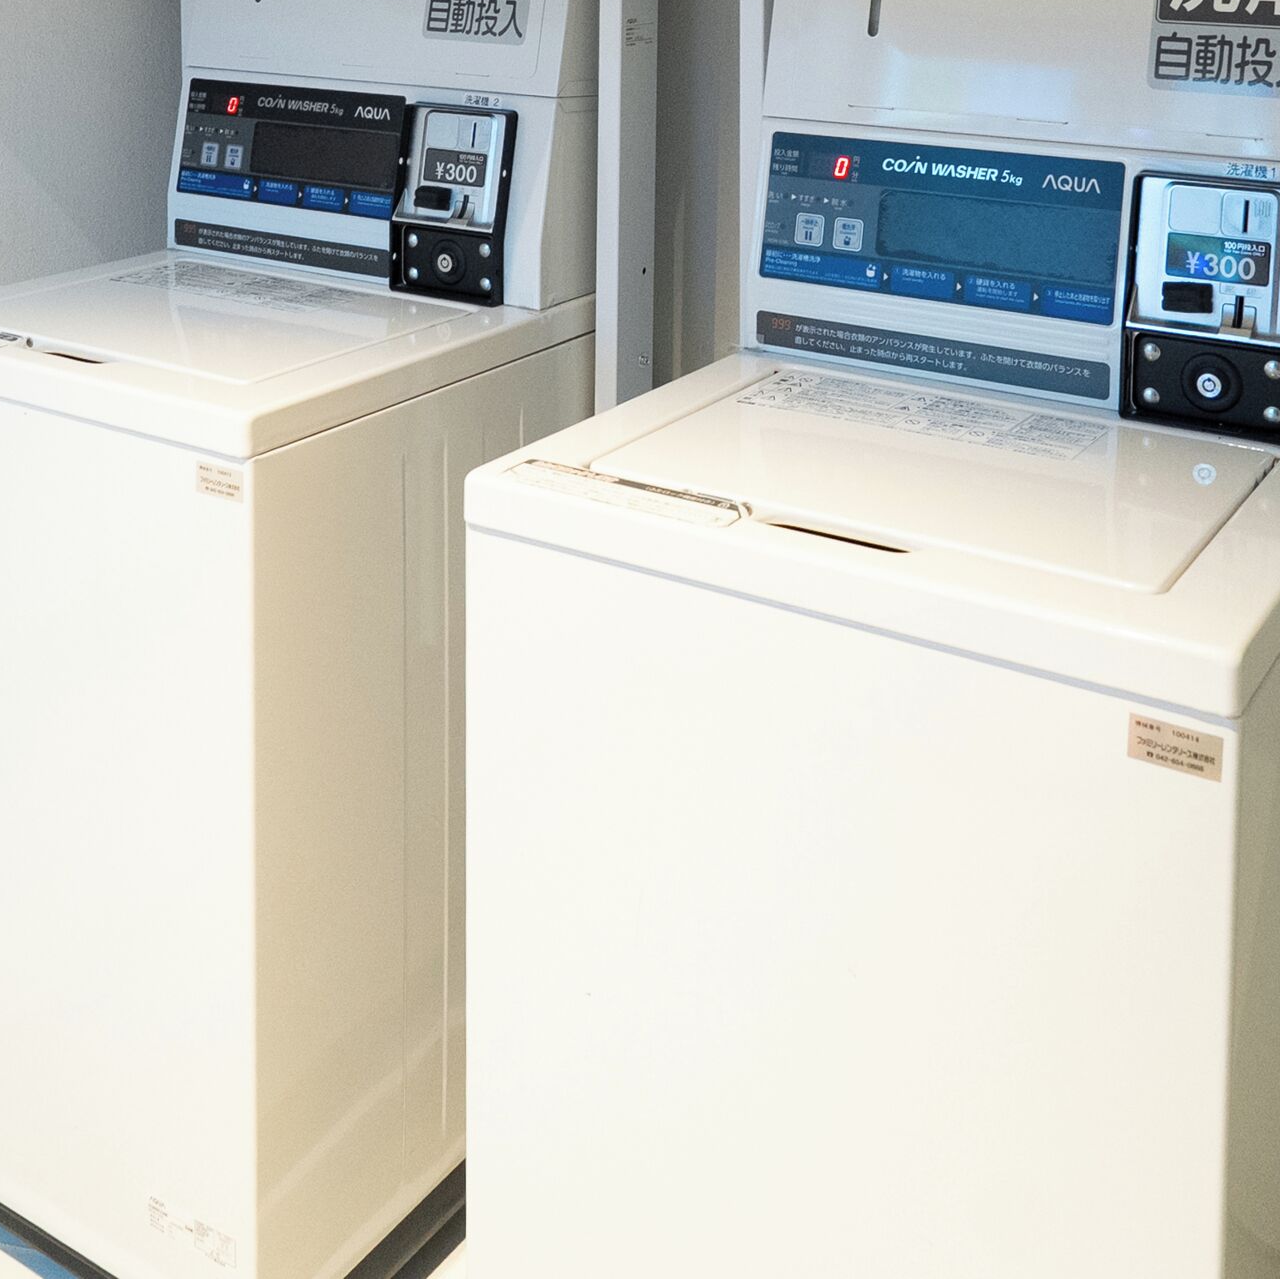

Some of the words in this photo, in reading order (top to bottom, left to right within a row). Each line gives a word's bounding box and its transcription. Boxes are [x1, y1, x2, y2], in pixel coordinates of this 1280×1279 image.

[227, 96, 239, 114] 0
[287, 100, 328, 114] WASHER
[493, 98, 500, 107] 2
[354, 106, 391, 120] AQUA
[435, 161, 477, 183] ¥300
[833, 156, 850, 178] 0
[931, 162, 998, 182] WASHER
[1000, 170, 1023, 186] 5kg
[1226, 162, 1268, 179] 洗濯機
[1042, 174, 1101, 194] AQUA
[1186, 250, 1256, 280] ¥300
